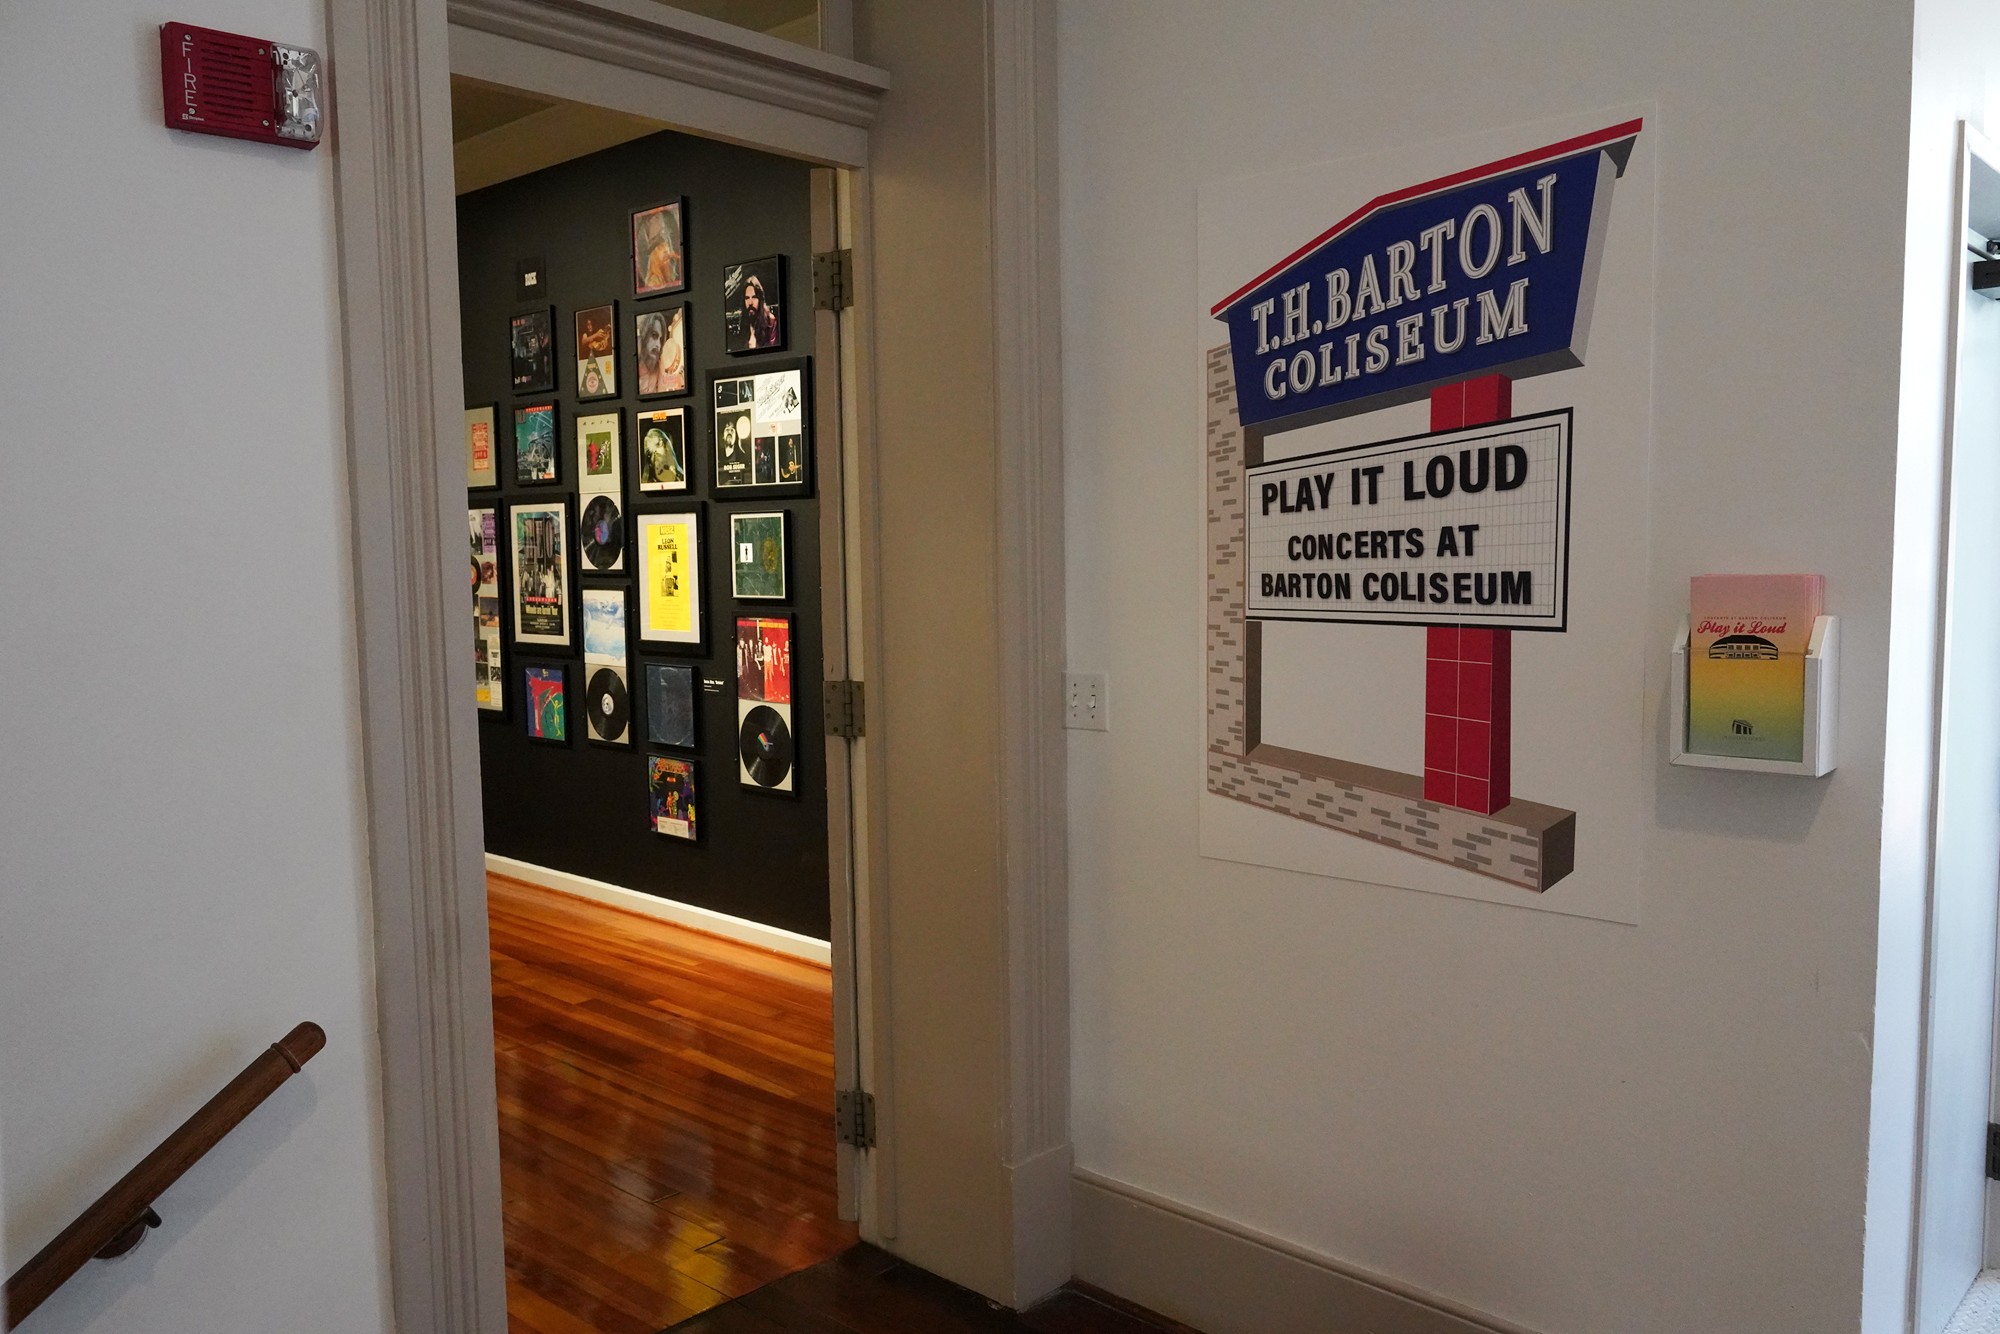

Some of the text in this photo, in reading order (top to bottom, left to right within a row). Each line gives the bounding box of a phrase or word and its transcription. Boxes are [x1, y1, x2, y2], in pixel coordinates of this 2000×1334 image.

[182, 42, 197, 106] FIRE
[1251, 173, 1557, 355] T.H. BARTON
[1263, 277, 1530, 400] COLISEUM
[1262, 444, 1528, 516] PLAY IT LOUD
[1288, 524, 1480, 561] CONCERTS AT
[1261, 570, 1532, 605] BARTON COLISEUM
[1697, 620, 1787, 637] Play it Loud
